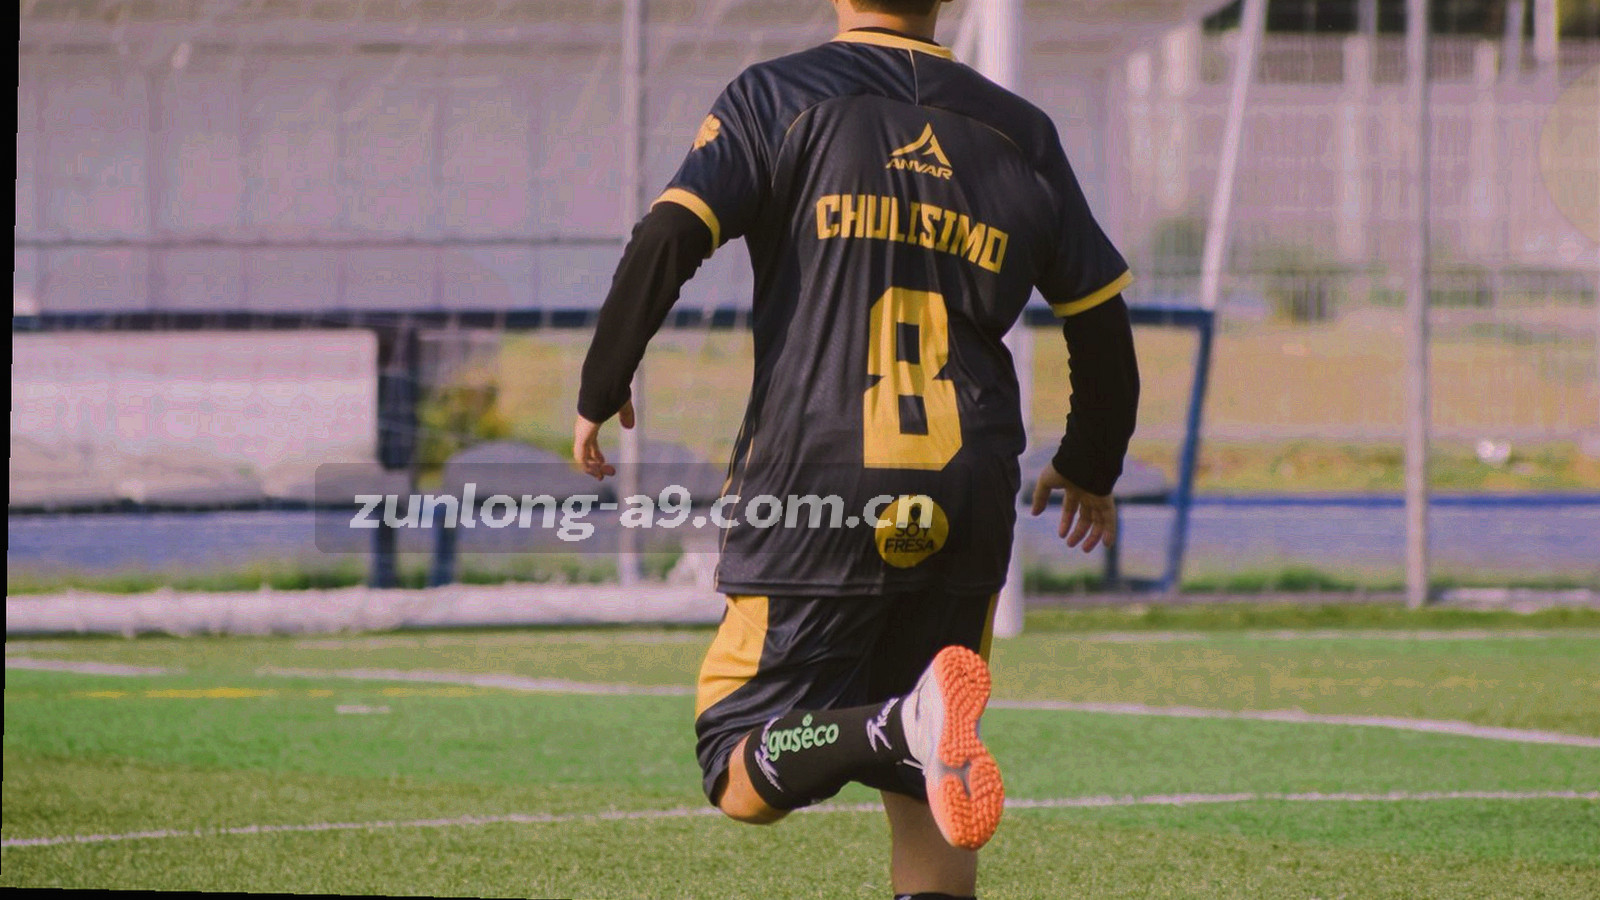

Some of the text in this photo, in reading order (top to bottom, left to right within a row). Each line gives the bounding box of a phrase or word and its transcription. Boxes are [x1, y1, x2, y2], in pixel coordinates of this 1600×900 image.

[885, 158, 953, 180] ANVAR
[816, 194, 1009, 274] CHULISIMO
[863, 286, 962, 471] 8
[895, 521, 930, 538] SOY
[884, 538, 935, 554] FRESA
